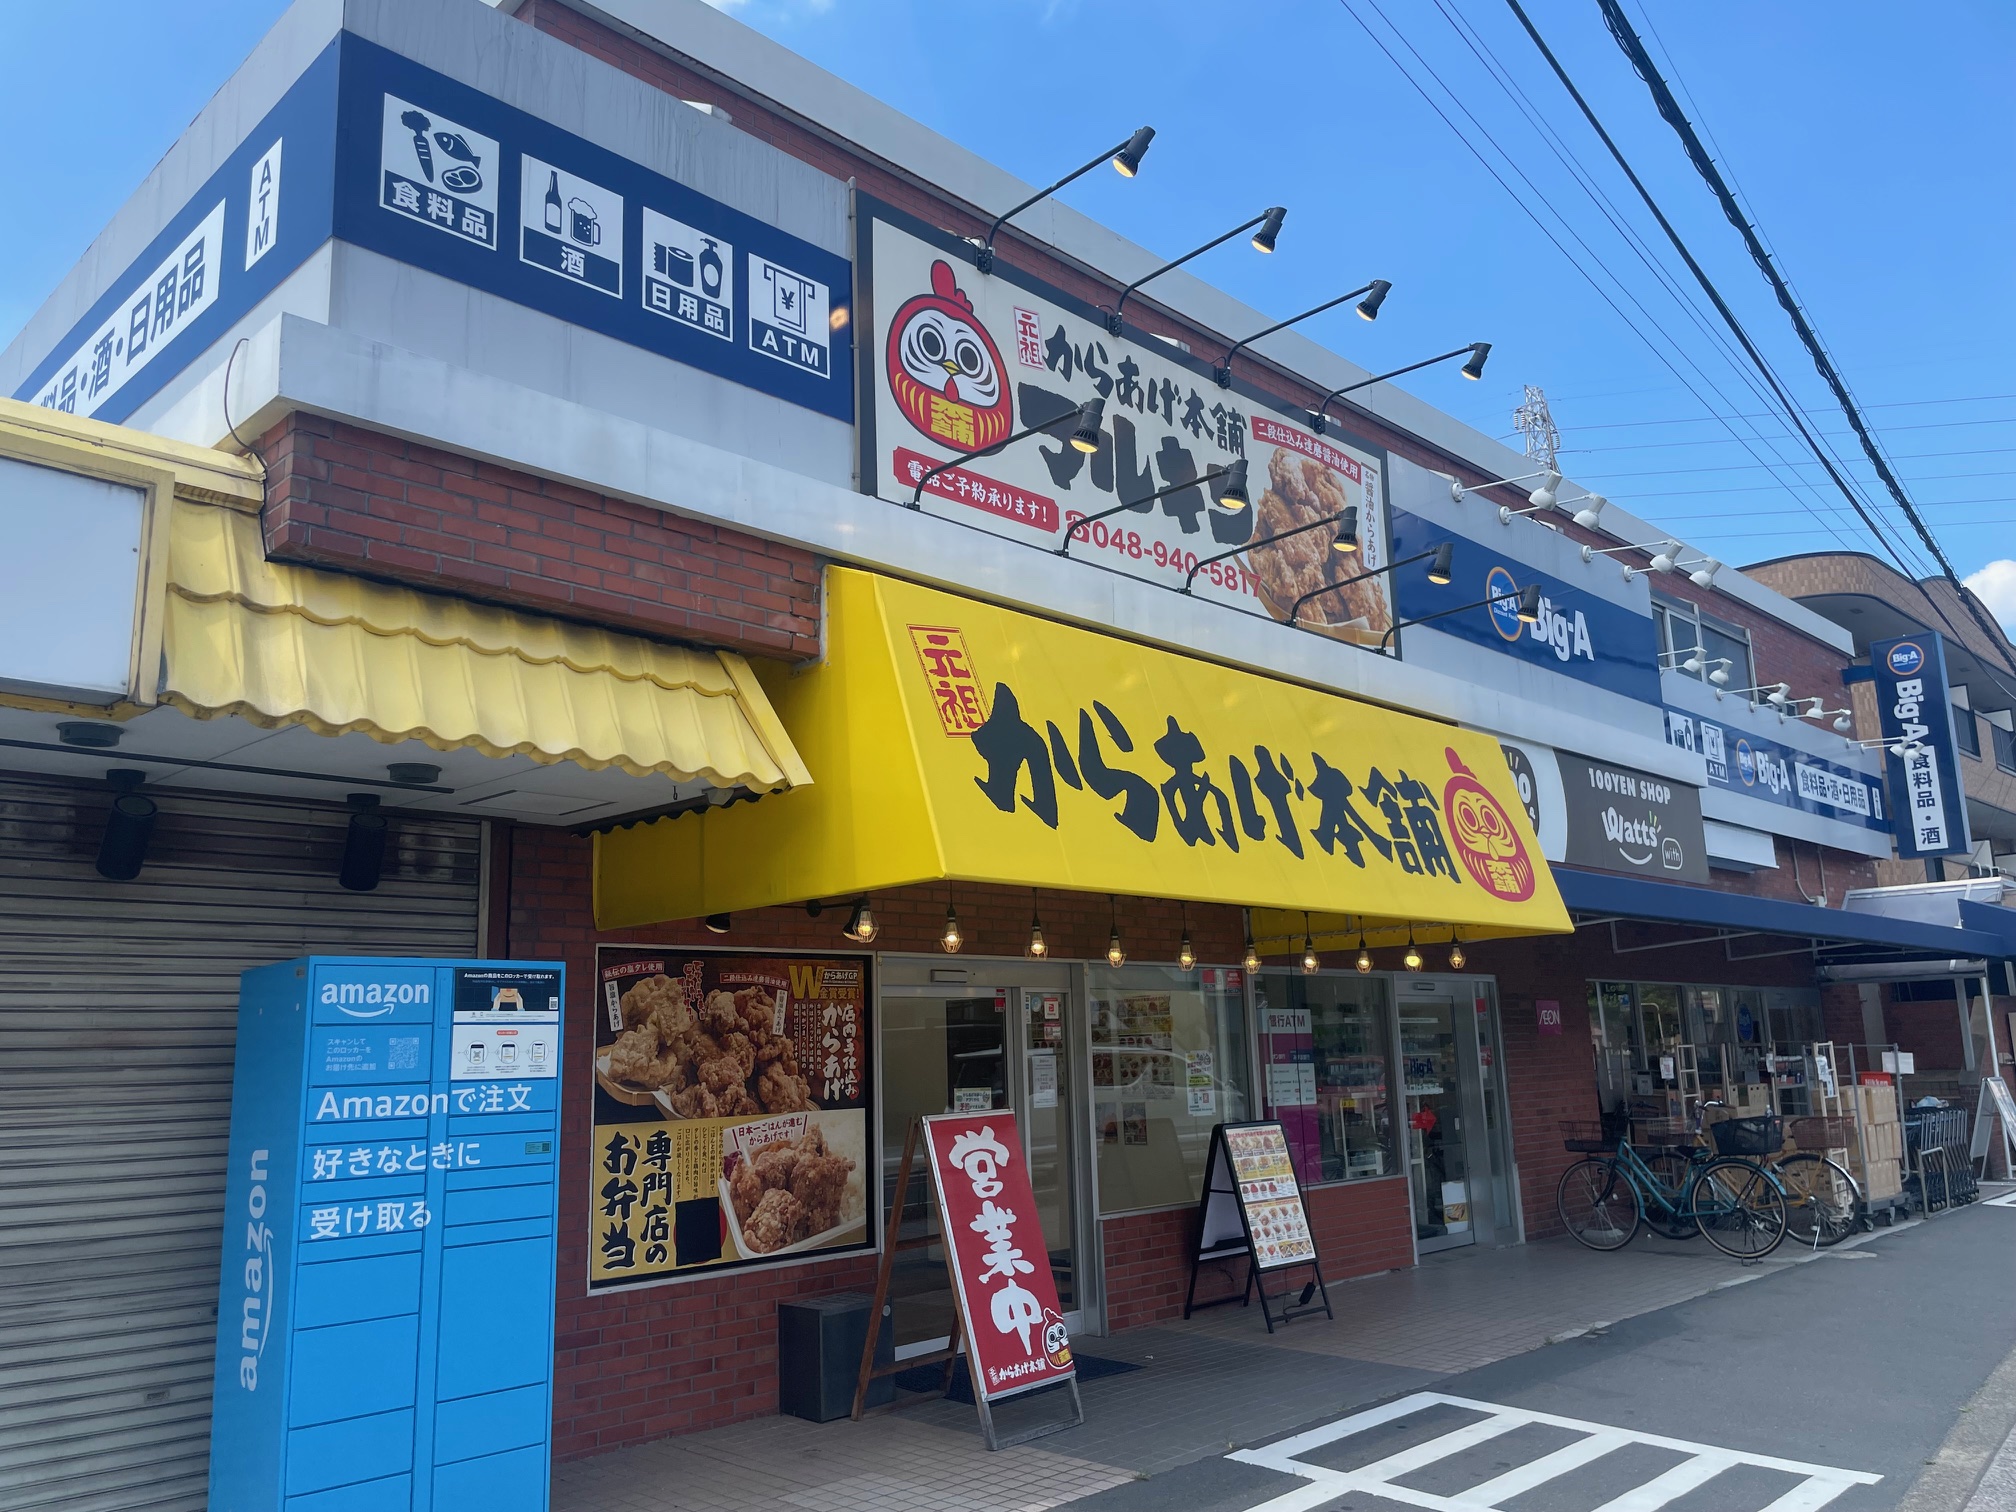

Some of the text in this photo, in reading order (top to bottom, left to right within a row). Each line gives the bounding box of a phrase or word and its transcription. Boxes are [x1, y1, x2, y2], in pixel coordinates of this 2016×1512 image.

[253, 159, 272, 256] ATM
[392, 182, 488, 240] 食料品
[560, 245, 585, 278] 酒
[41, 236, 205, 414] 品・酒・日用品
[652, 282, 724, 332] 日用品
[762, 330, 819, 367] ATM
[1018, 313, 1043, 366] 元祖
[1044, 325, 1247, 459] からあげ本舗
[1258, 422, 1359, 480] 二段仕込み達磨醤油使用
[907, 460, 1049, 523] 電話ご予約承ります!
[1365, 482, 1376, 567] 醤油からあげ
[1093, 522, 1262, 598] 048-940-5817
[926, 634, 986, 730] 元祖
[971, 682, 1461, 883] からあげ本舗
[1588, 767, 1671, 805] 100YEN SHOP
[1709, 763, 1726, 778] ATM
[1755, 751, 1791, 795] Big-A
[1801, 769, 1866, 810] 食料品・酒・日用品
[1602, 806, 1658, 848] Watts
[1663, 847, 1681, 863] with
[321, 982, 430, 1005] amazon
[788, 965, 825, 999] W
[824, 971, 858, 980] からあげGP
[327, 1038, 367, 1046] スキャンして
[1268, 1014, 1305, 1028] 銀行ATM
[326, 1046, 372, 1054] このロッカーを
[326, 1055, 363, 1063] Amazonの
[821, 1002, 845, 1101] からあげ
[842, 1003, 857, 1097] 店内手仕込み
[316, 1084, 532, 1120] Amazonで注文
[738, 1117, 803, 1137] 日本一ごはんが進む
[749, 1130, 794, 1146] からあげです!
[312, 1142, 481, 1180] 好きなときに
[600, 1131, 641, 1270] お弁当
[640, 1130, 673, 1264] 専門店の
[310, 1201, 432, 1240] 受け取る
[949, 1125, 1043, 1356] 営業中
[240, 1149, 269, 1392] amazon
[999, 1357, 1047, 1381] からあげ本舗
